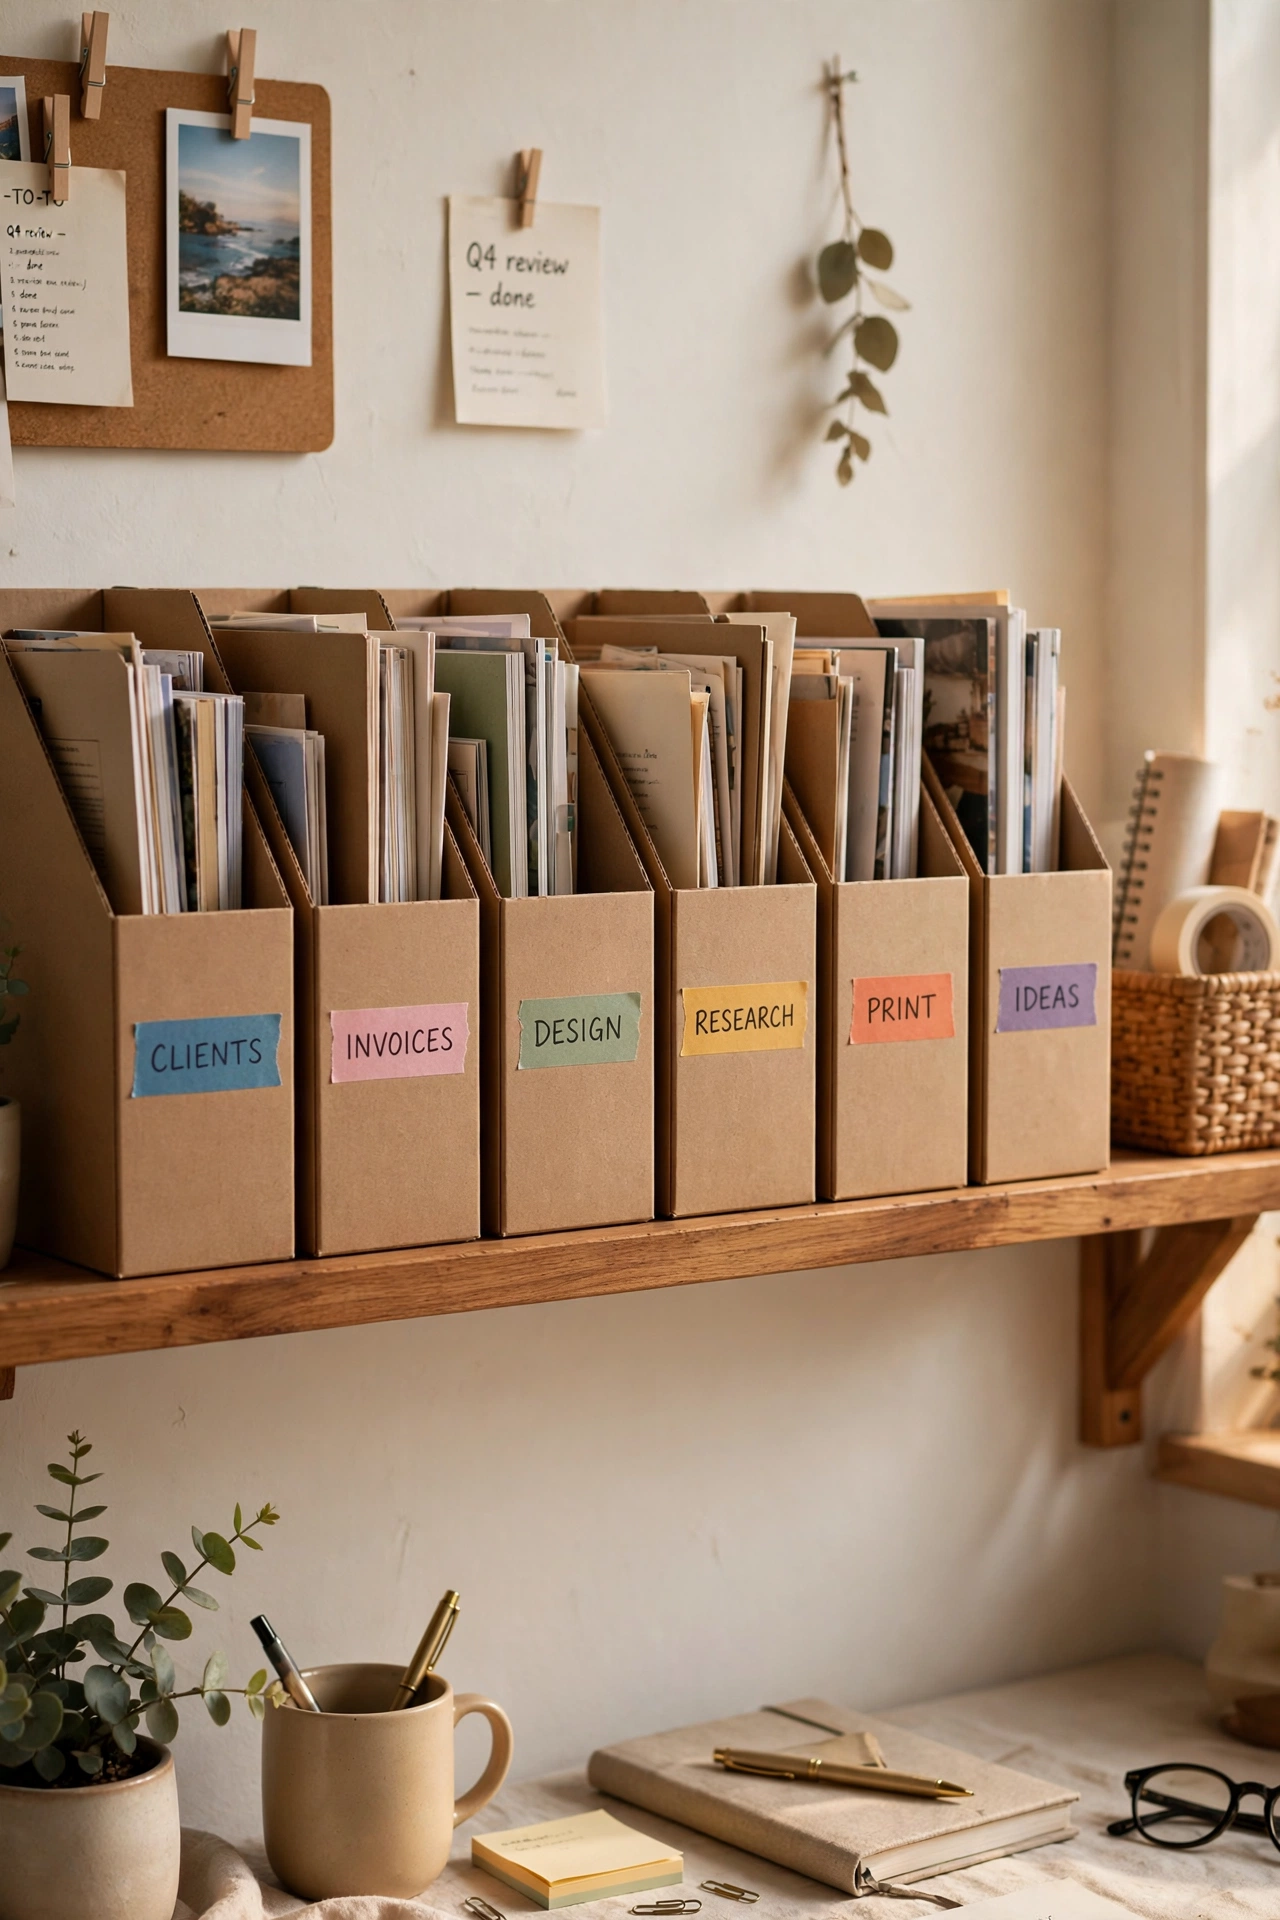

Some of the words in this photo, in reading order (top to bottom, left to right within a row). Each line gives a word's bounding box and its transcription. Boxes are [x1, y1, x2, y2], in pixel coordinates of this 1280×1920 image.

[7, 225, 21, 238] Q4
[25, 227, 53, 239] review
[466, 241, 496, 271] Q4
[506, 250, 569, 274] review
[490, 281, 535, 308] done
[868, 993, 937, 1024] PRINT
[1016, 983, 1079, 1012] IDEAS
[534, 1014, 621, 1047] DESIGN
[695, 1003, 794, 1035] RESEARCH
[151, 1037, 262, 1073] CLIENTS
[347, 1026, 453, 1060] INVOICES
